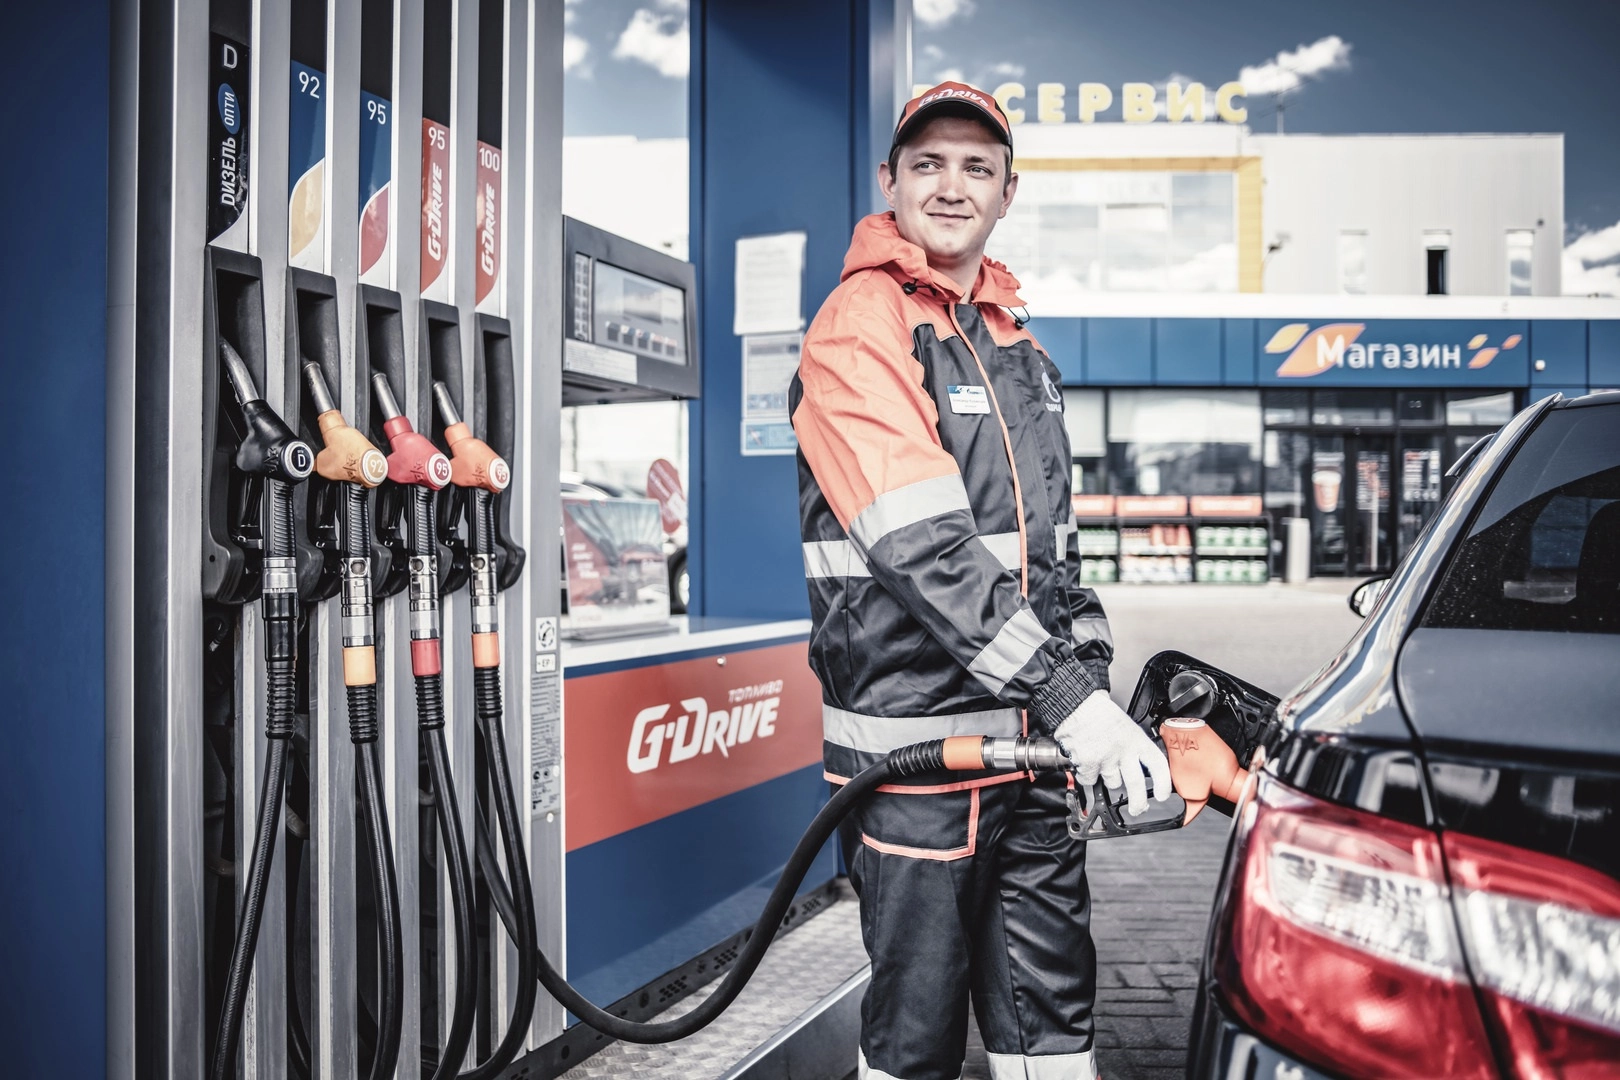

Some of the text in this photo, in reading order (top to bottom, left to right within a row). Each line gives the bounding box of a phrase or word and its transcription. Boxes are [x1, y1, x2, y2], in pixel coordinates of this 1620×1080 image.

[223, 43, 238, 70] D
[299, 71, 321, 99] 92
[224, 91, 236, 127] ОПТИ
[367, 100, 387, 125] 95
[912, 82, 1248, 124] СЕРВИС
[428, 127, 446, 151] 95
[479, 148, 500, 173] 100
[1316, 334, 1461, 369] Магазин
[297, 453, 306, 468] D
[370, 459, 384, 473] 92
[436, 462, 448, 476] 95
